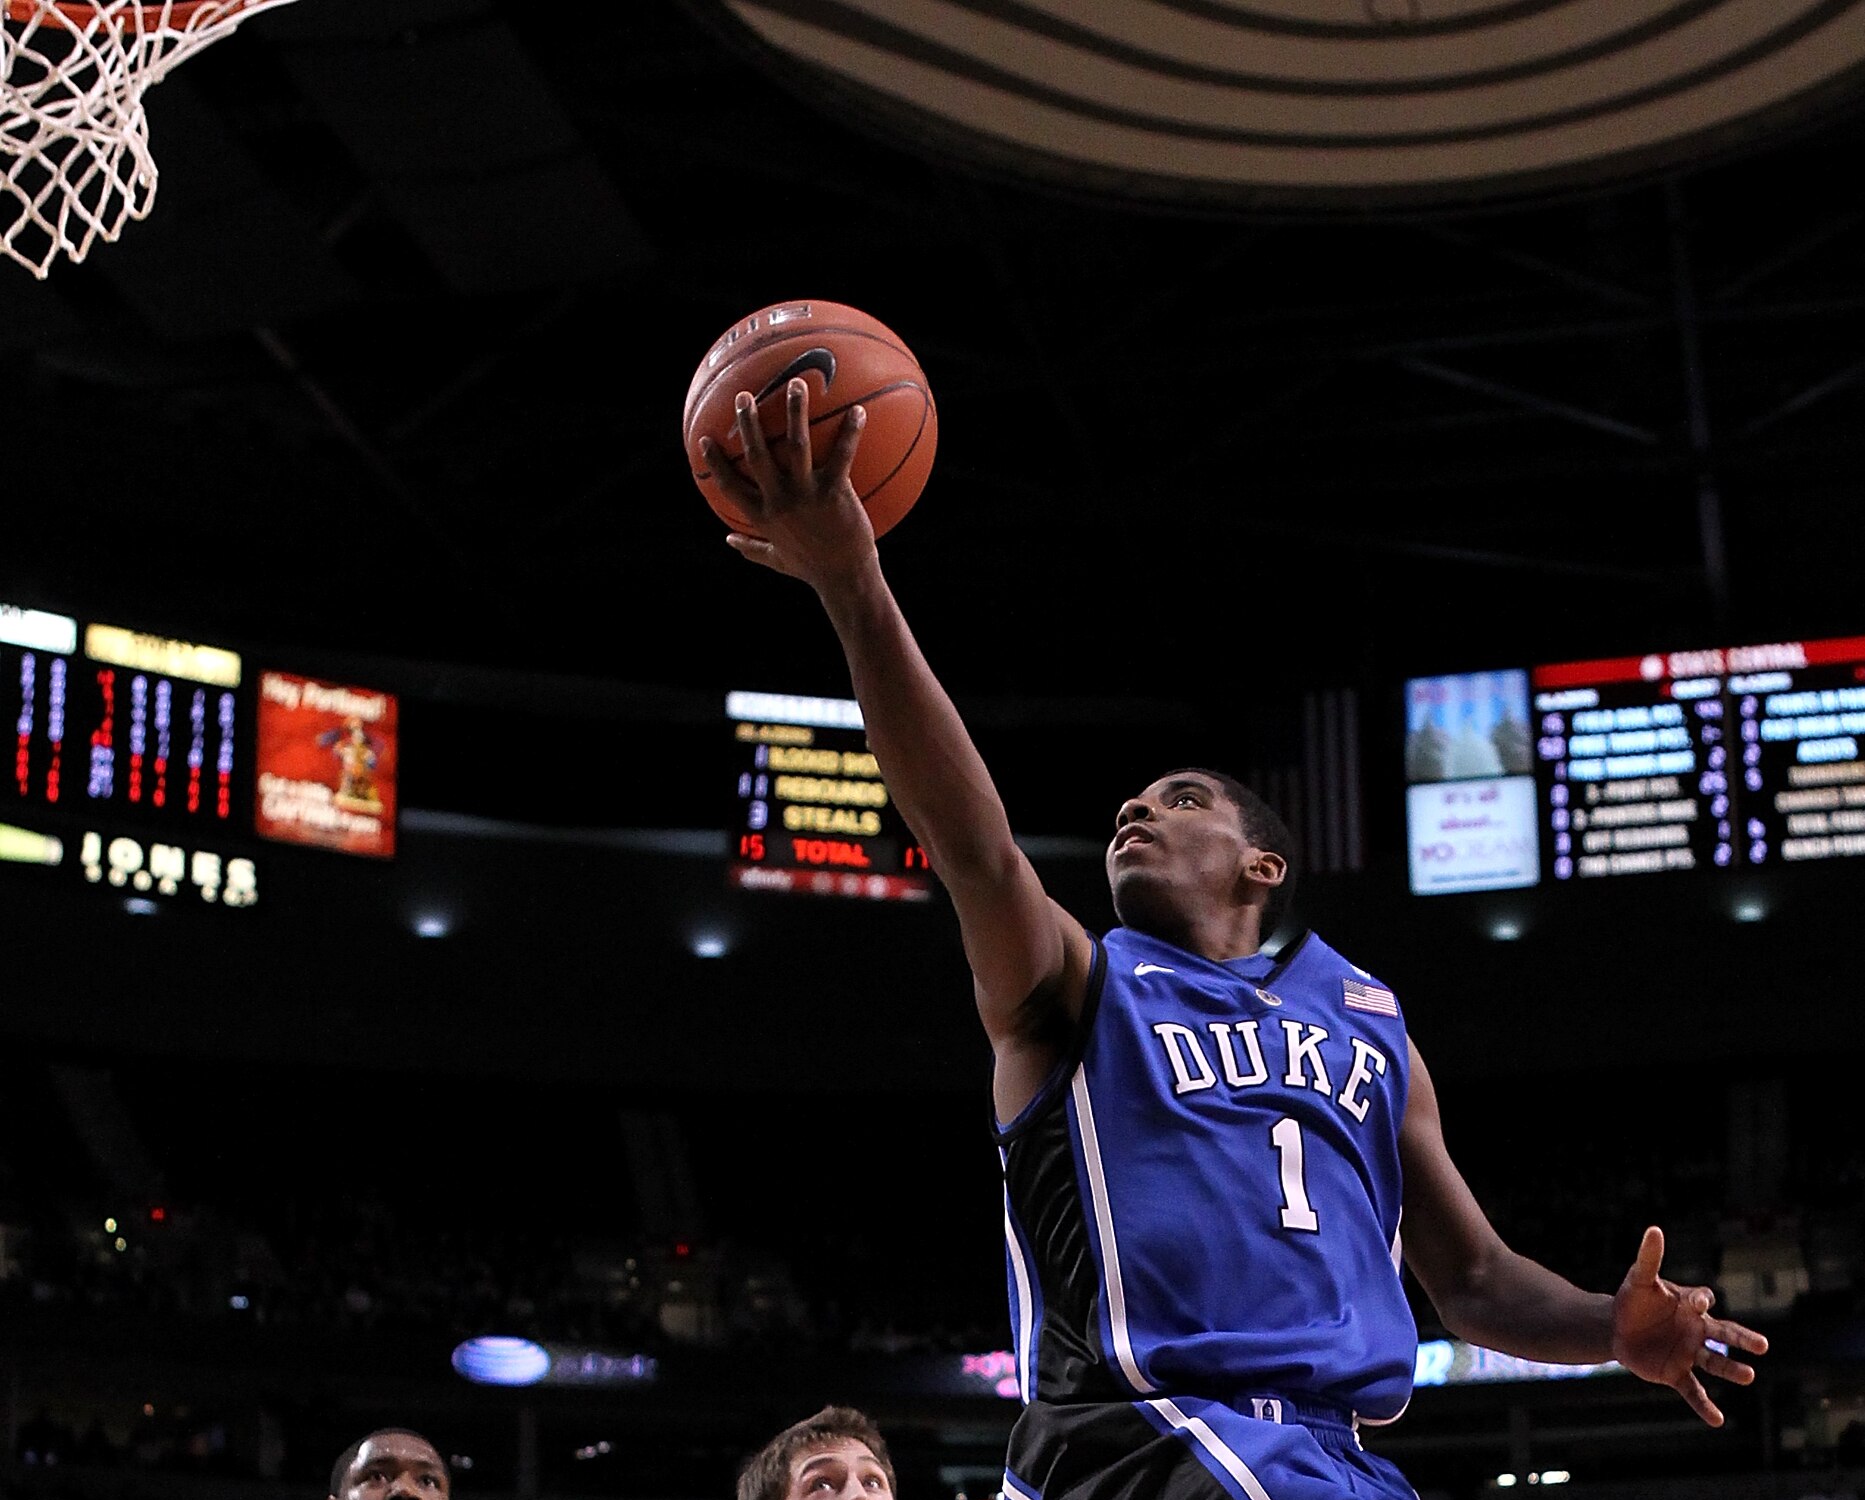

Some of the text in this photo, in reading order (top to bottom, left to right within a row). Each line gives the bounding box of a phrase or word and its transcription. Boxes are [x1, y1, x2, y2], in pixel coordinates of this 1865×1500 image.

[740, 834, 766, 861] 15
[792, 838, 871, 868] TOTAL
[783, 805, 882, 837] STEALS
[1152, 1019, 1388, 1125] DUKE
[1270, 1116, 1320, 1234] 1
